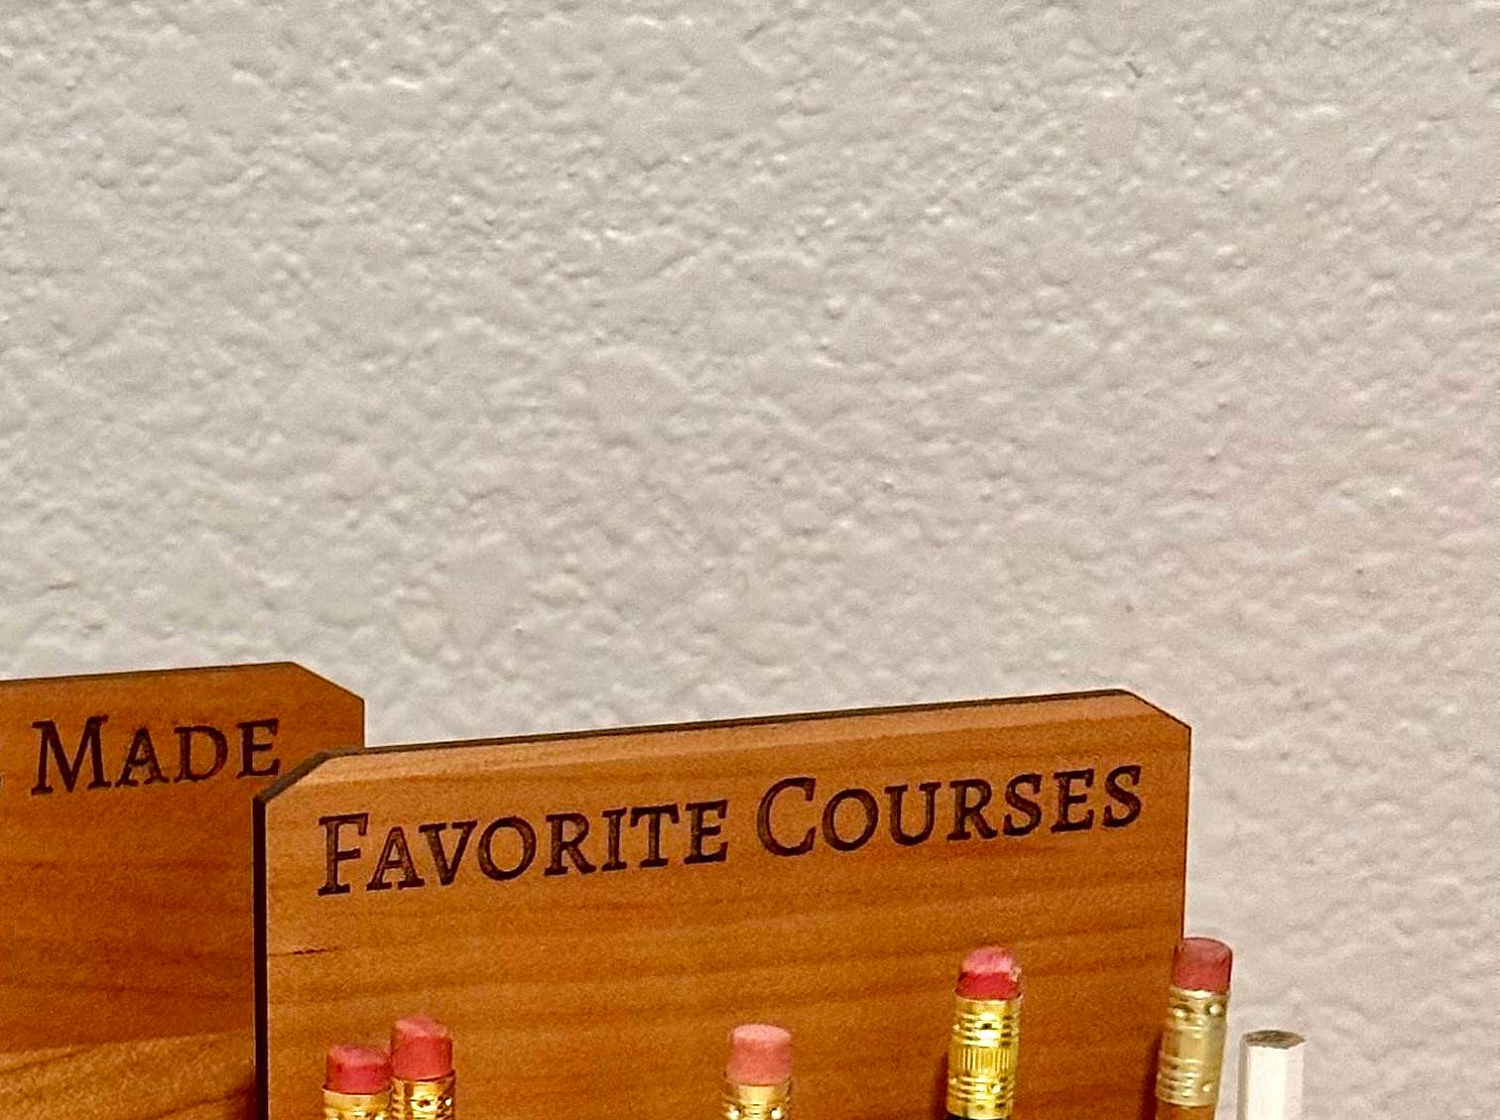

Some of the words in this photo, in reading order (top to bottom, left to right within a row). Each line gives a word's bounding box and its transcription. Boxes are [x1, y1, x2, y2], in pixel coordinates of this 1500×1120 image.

[31, 715, 280, 795] MADE
[318, 800, 728, 895] FAVORITE
[756, 765, 1142, 857] COURSES
